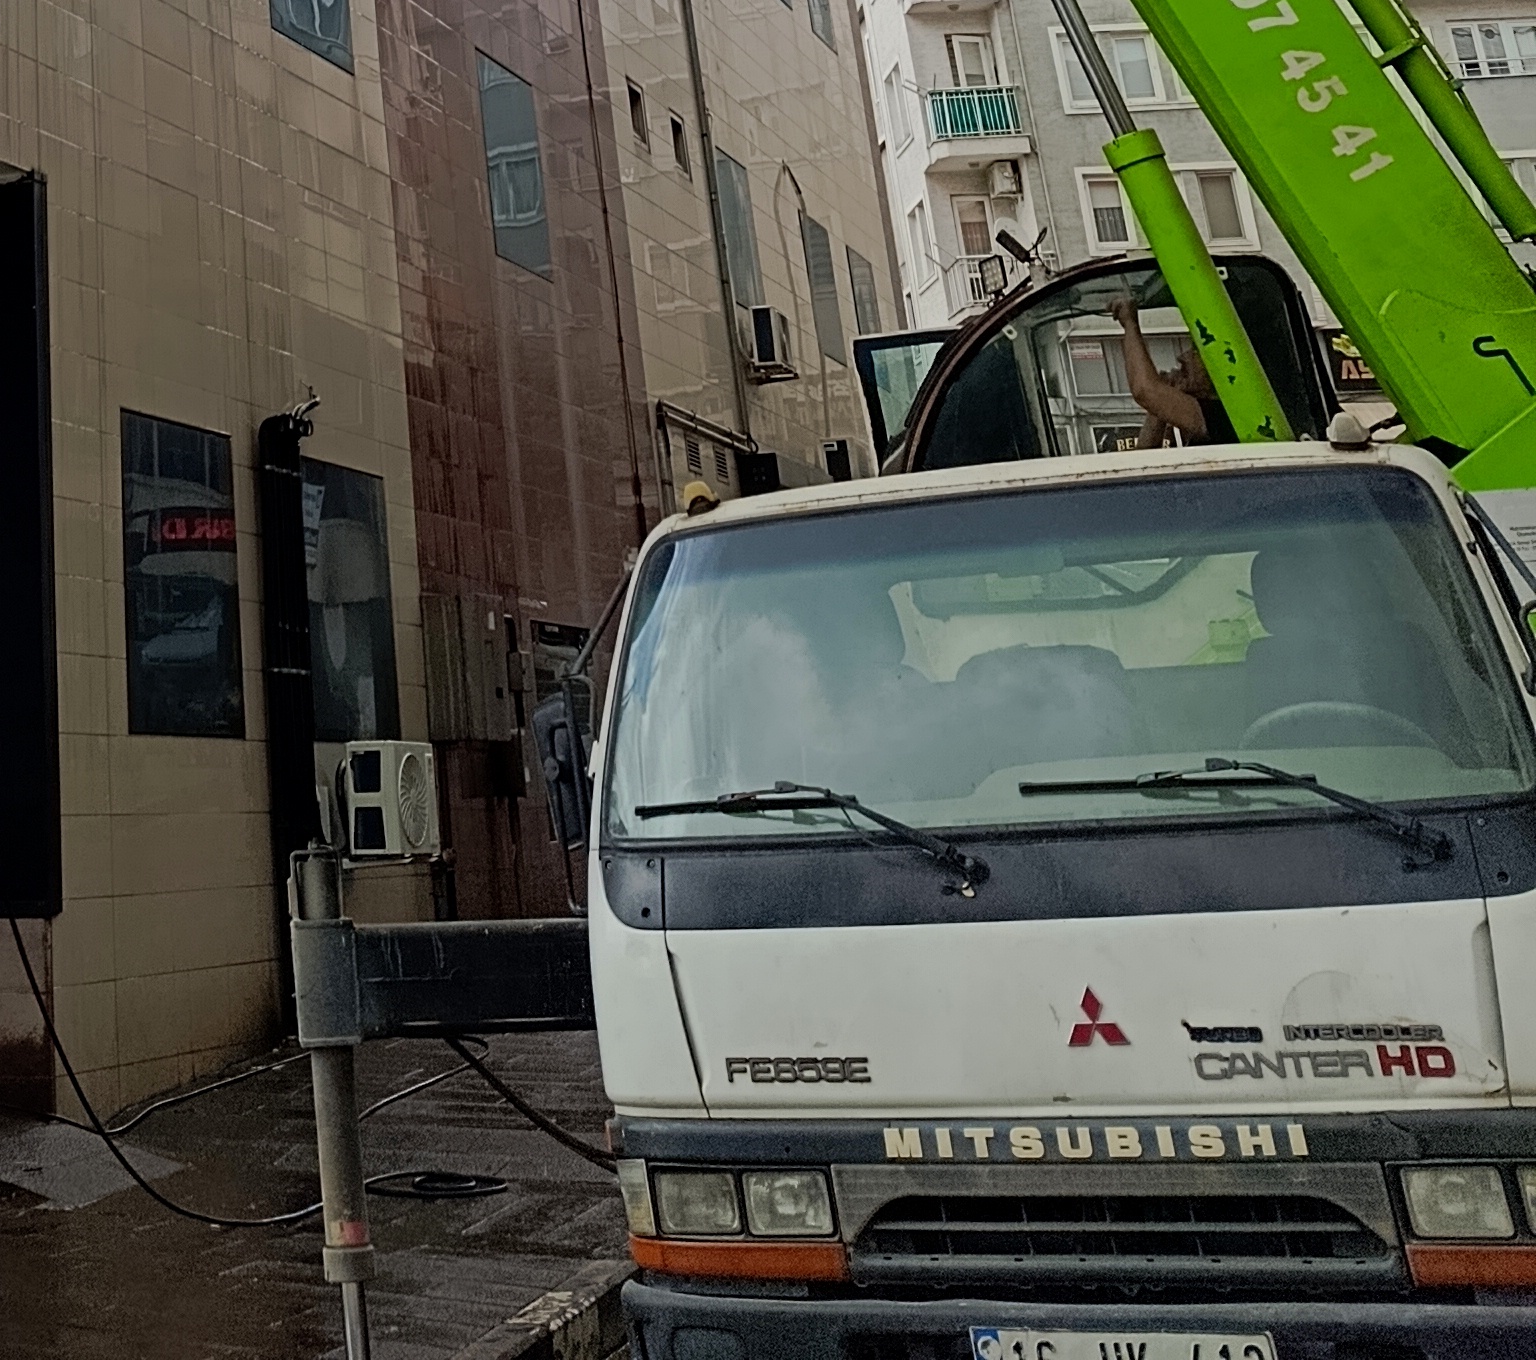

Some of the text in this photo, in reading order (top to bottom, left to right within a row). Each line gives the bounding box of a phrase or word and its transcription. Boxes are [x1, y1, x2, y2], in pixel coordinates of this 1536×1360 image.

[1280, 49, 1349, 113] 45
[1331, 125, 1395, 183] 41
[1282, 1024, 1446, 1042] INTERCOOLER
[1193, 1044, 1457, 1081] CANTER HD
[882, 1123, 1310, 1159] MITSUBISHI
